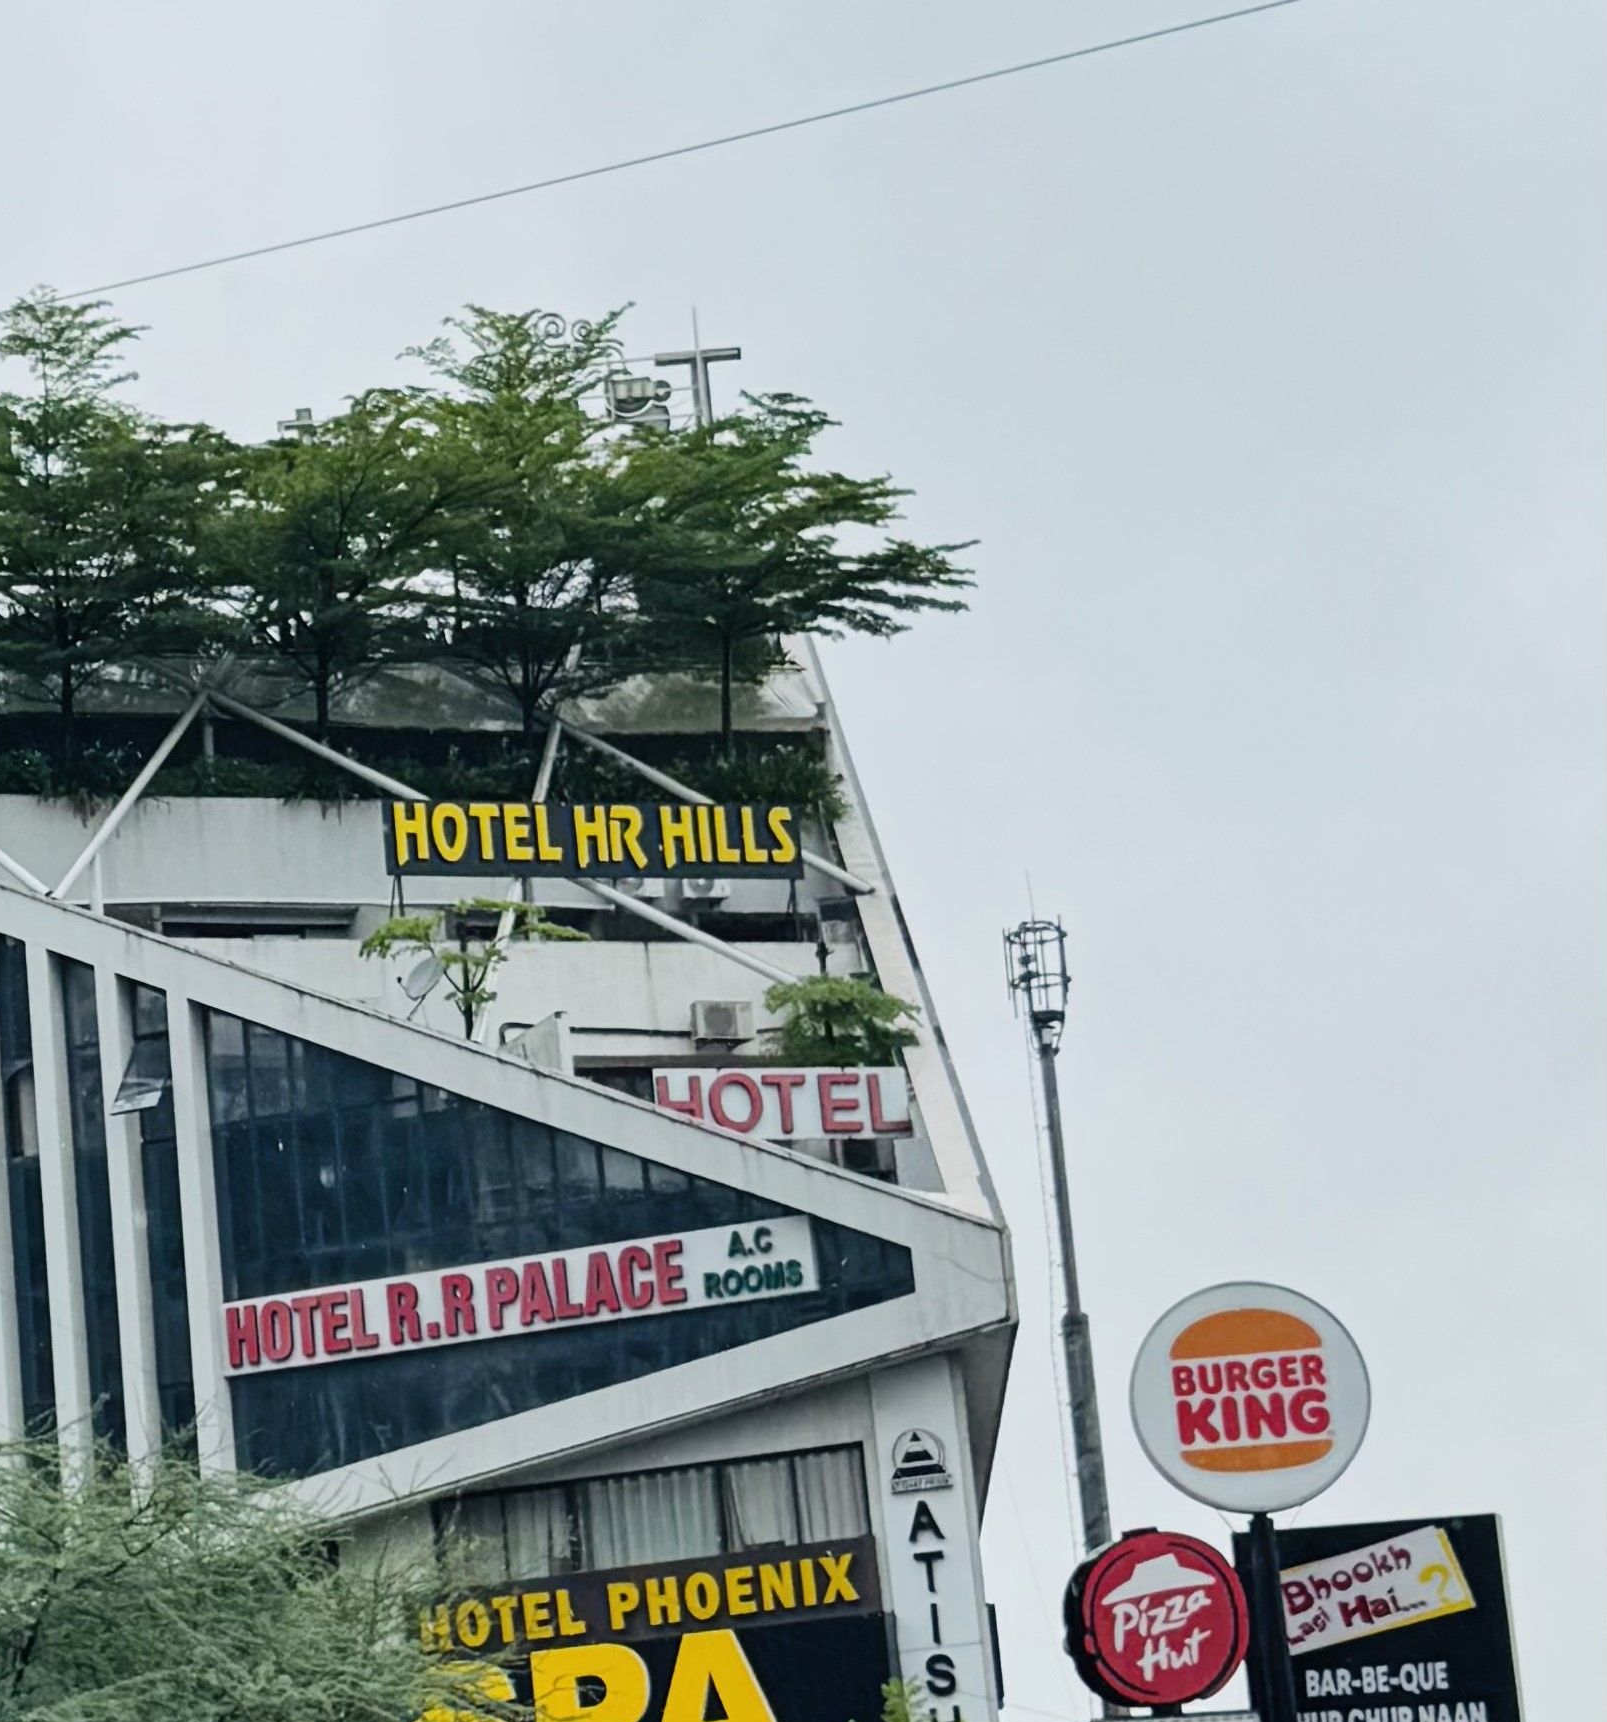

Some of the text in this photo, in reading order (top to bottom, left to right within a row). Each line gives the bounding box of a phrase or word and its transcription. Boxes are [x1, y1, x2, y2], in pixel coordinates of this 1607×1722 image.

[393, 801, 796, 871] HOTEL HR HILLS
[655, 1073, 913, 1134] HOTEL
[727, 1226, 773, 1257] A.C
[226, 1239, 688, 1368] HOTEL R.R PALACE
[702, 1259, 803, 1299] ROOMS
[1172, 1354, 1326, 1397] BURGER
[1176, 1388, 1331, 1446] KING
[421, 1553, 860, 1653] HOTEL PHOENIX
[1281, 1545, 1412, 1615] Bhookh
[1112, 1590, 1213, 1653] Pizza
[1136, 1627, 1212, 1682] Hut
[1305, 1661, 1449, 1698] BAR-BE-QUE
